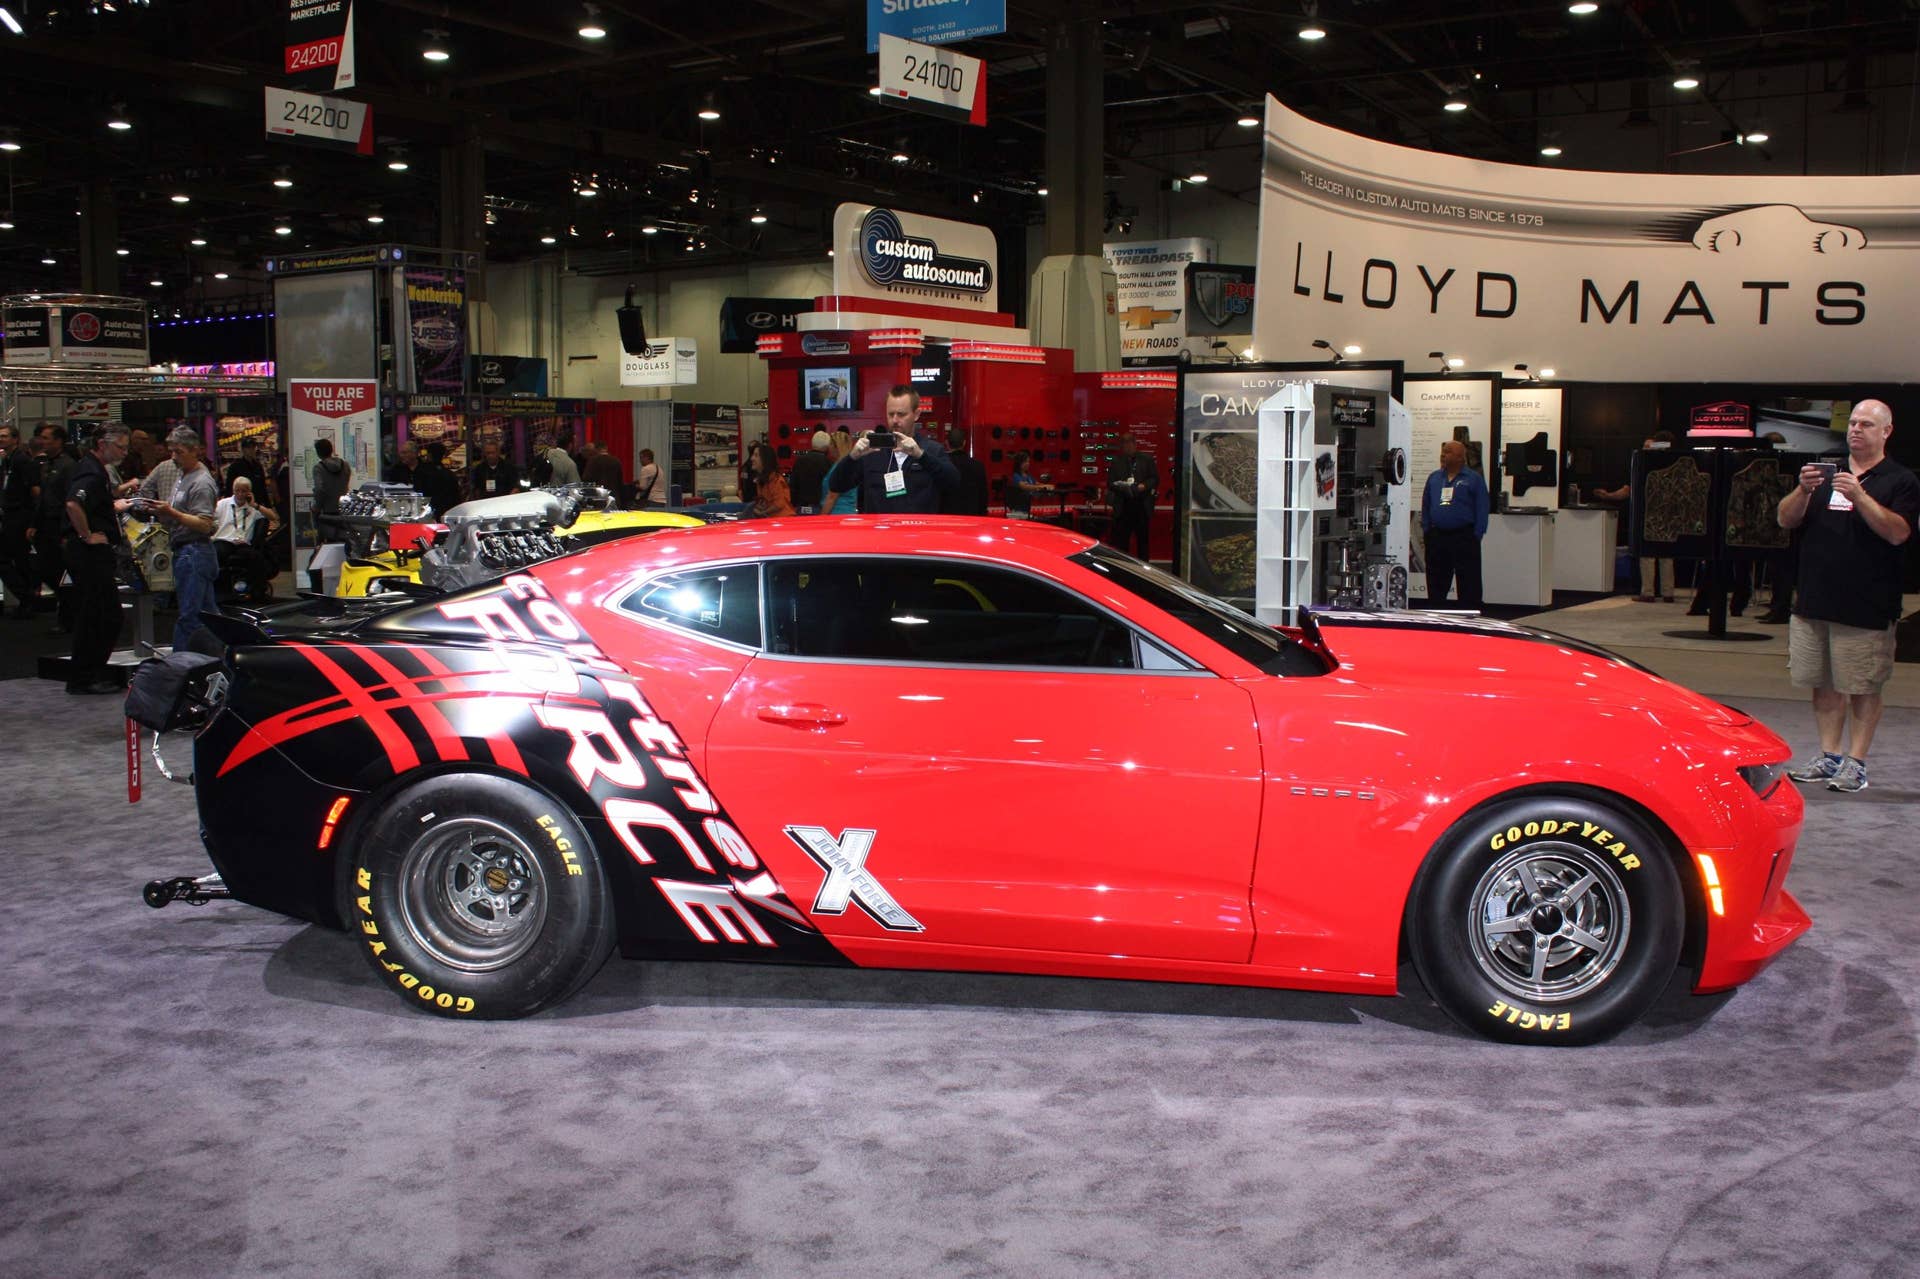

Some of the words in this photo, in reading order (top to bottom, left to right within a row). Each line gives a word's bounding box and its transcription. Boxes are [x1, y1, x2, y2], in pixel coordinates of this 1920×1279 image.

[290, 2, 341, 20] MARKETPLACE
[928, 30, 965, 41] SOLUTIONS
[966, 24, 998, 36] COMPANY
[291, 42, 338, 68] 24200
[903, 56, 963, 93] 24100
[284, 102, 349, 130] 24200
[1300, 171, 1314, 187] THE
[1315, 175, 1344, 196] LEADER
[1345, 186, 1355, 199] IN
[1356, 189, 1398, 208] CUSTOM
[1400, 198, 1430, 214] AUTO
[1432, 203, 1466, 218] MATS
[1469, 208, 1505, 223] SINCE
[1510, 213, 1544, 226] 1978
[875, 240, 933, 261] custom
[1115, 252, 1194, 266] TREADPASS
[903, 262, 984, 287] autosound
[1118, 272, 1139, 280] SOUTH
[1294, 241, 1517, 319] LLOYD
[1580, 279, 1866, 325] MATS
[407, 284, 463, 309] Weatherstrip
[1225, 297, 1248, 313] 15
[625, 362, 670, 371] DOUGLASS
[303, 387, 333, 399] YOU
[336, 387, 365, 399] ARE
[1241, 379, 1286, 388] LLOYD
[315, 400, 353, 412] HERE
[1200, 393, 1265, 416] CAM
[1502, 401, 1533, 409] ERBER
[435, 594, 779, 948] FORCE
[1290, 786, 1375, 800] COPO
[536, 813, 583, 876] EAGLE
[811, 835, 857, 876] JOHN
[1490, 820, 1642, 871] GOODYEAR
[850, 874, 899, 920] FORCE
[356, 867, 475, 1013] GOODYEAR
[1488, 1000, 1571, 1030] EAGLE
